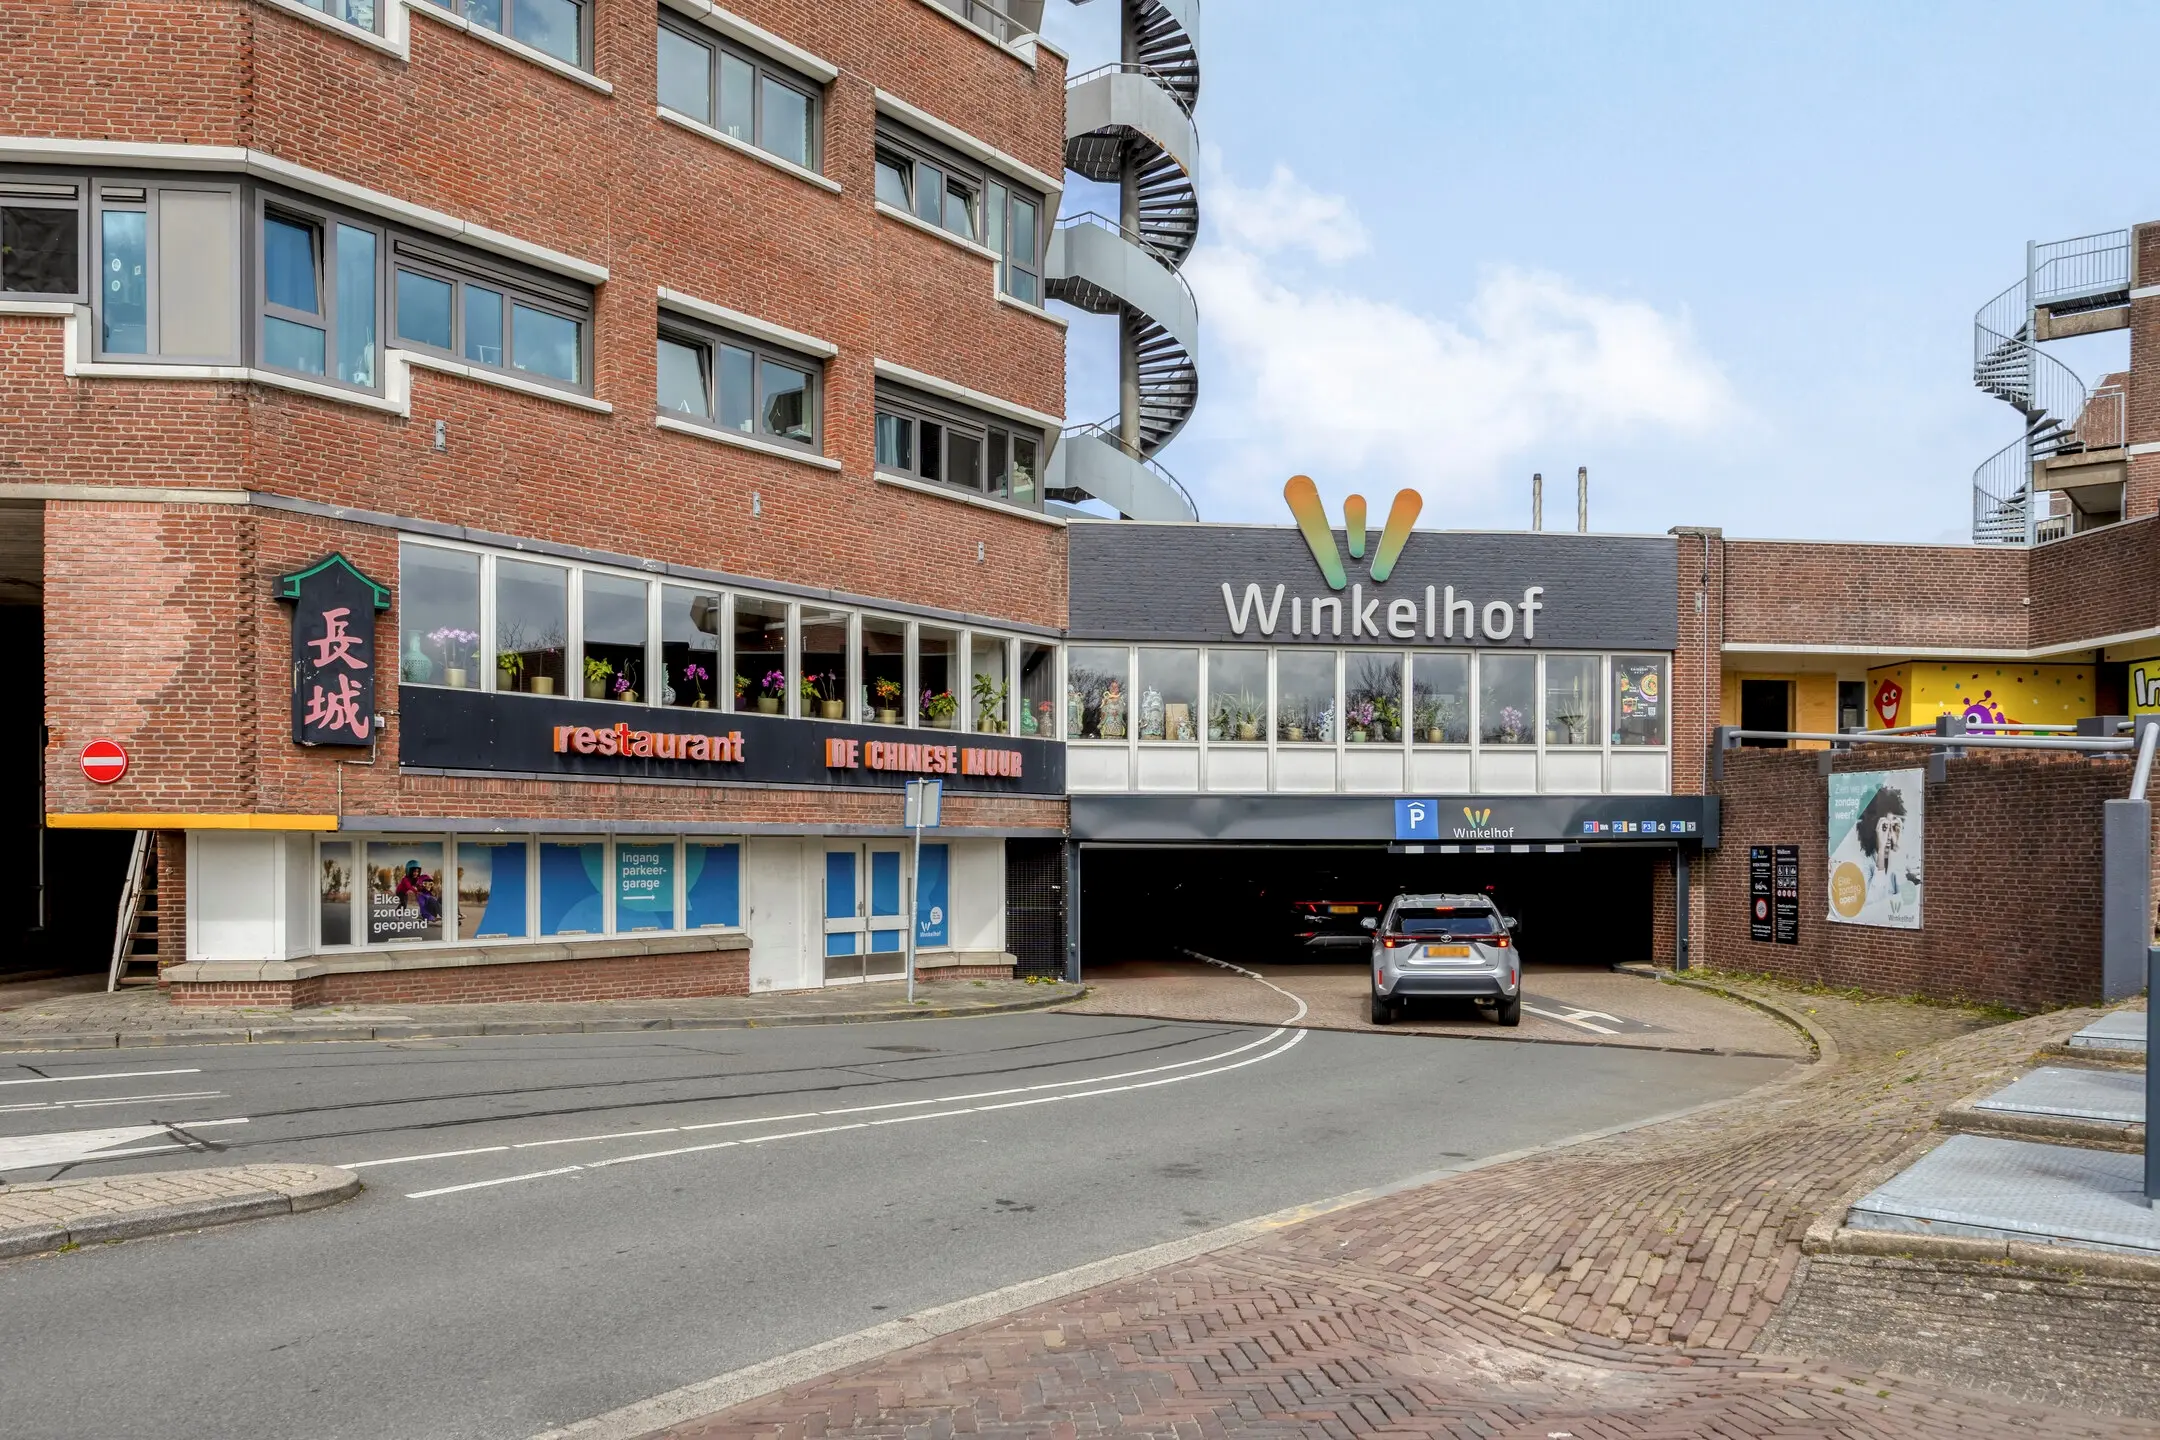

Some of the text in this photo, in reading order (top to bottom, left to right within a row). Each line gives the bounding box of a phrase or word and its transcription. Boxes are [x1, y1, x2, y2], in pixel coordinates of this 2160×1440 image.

[1221, 582, 1544, 640] Winkelhof
[304, 607, 370, 739] 長城
[554, 722, 745, 763] restaurant
[825, 738, 1022, 778] DE CHINESE MUUR
[1834, 797, 1860, 810] zondag
[1410, 808, 1425, 830] P
[1453, 827, 1515, 838] Winkelhof
[1584, 822, 1594, 831] P1
[1613, 822, 1623, 831] P2
[1642, 822, 1652, 831] P3
[1671, 822, 1681, 831] P4
[622, 852, 660, 865] Ingang
[622, 865, 667, 878] parkeer-
[622, 879, 660, 891] garage
[373, 893, 400, 905] Elke
[373, 906, 420, 920] zondag
[373, 918, 428, 934] geopend
